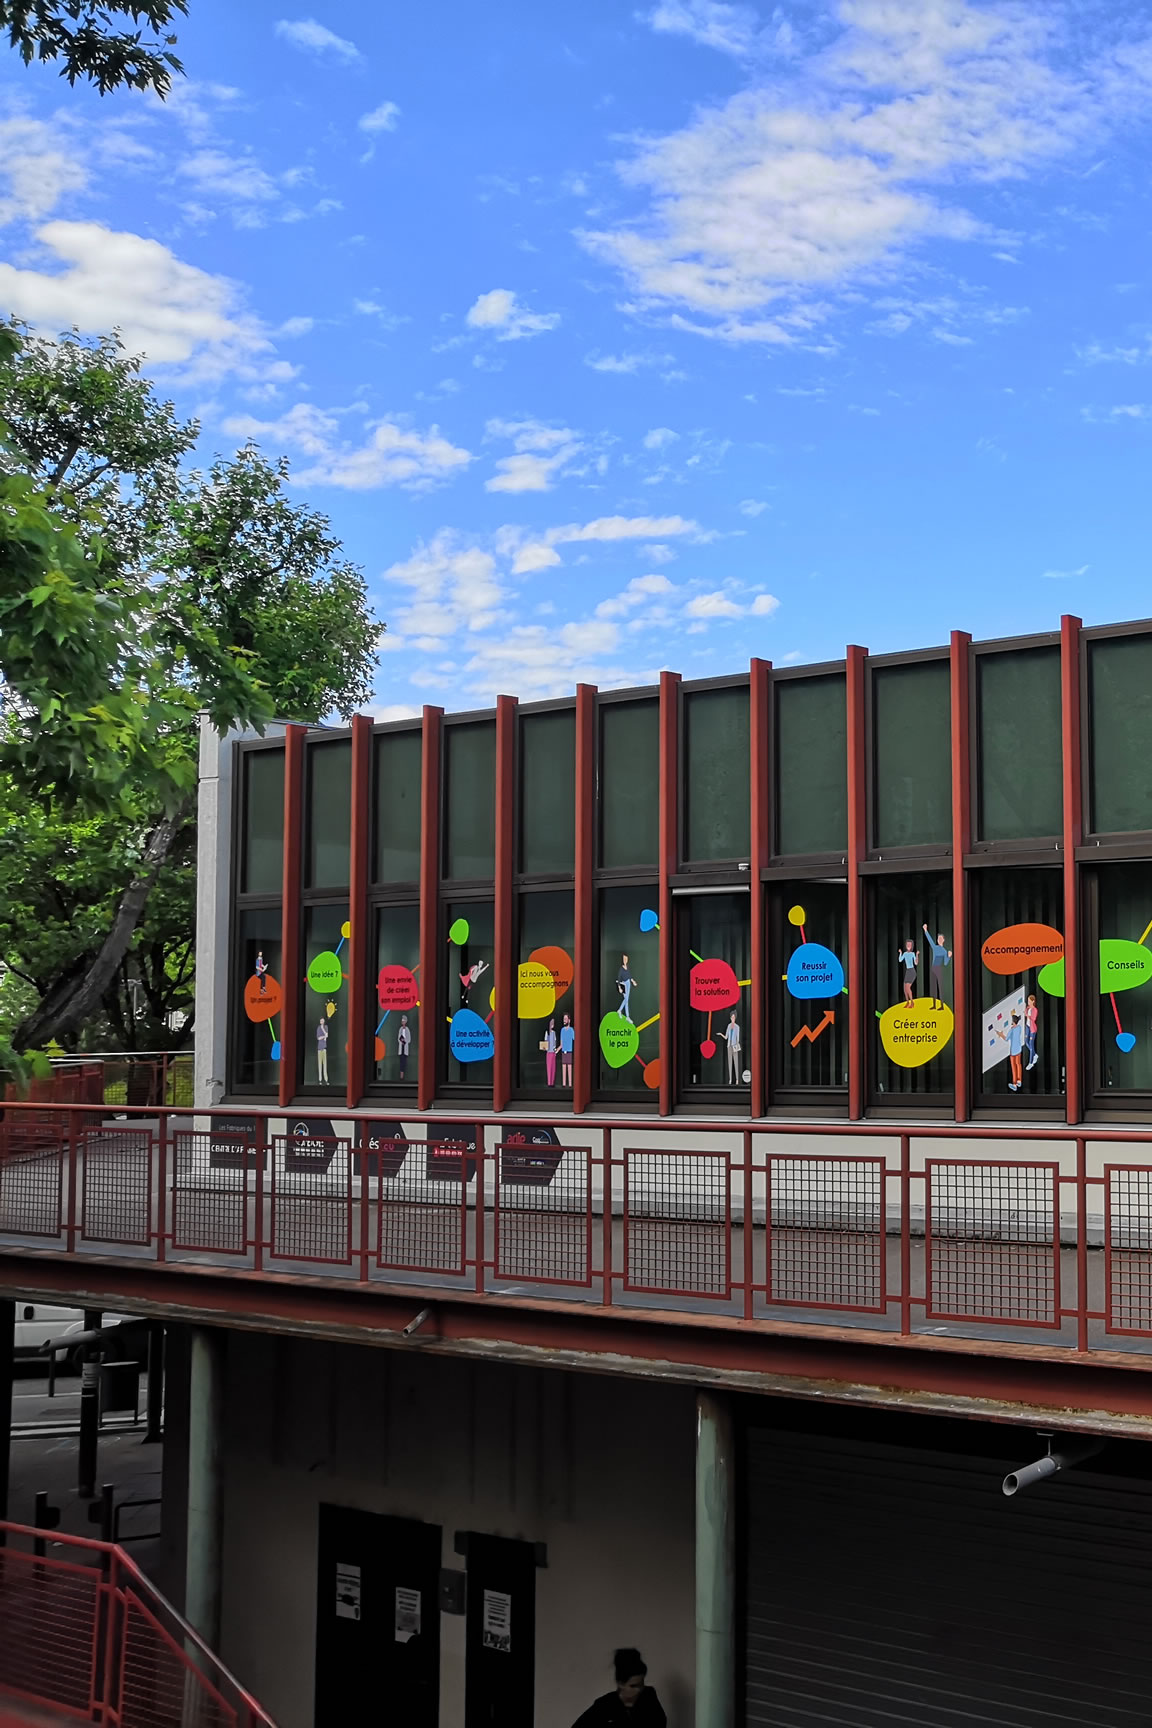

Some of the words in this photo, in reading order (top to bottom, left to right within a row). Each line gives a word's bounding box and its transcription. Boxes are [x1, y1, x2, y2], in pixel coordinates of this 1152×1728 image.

[984, 944, 1063, 955] Accompagnement
[1107, 960, 1145, 970] Conseils
[695, 976, 720, 985] Trouver
[811, 973, 833, 983] projet
[520, 980, 569, 989] accompagnons
[695, 988, 701, 996] la
[703, 987, 730, 996] solution
[893, 1018, 918, 1029] Créer
[921, 1020, 937, 1029] son
[606, 1028, 632, 1037] Franchir
[893, 1033, 938, 1044] entreprise
